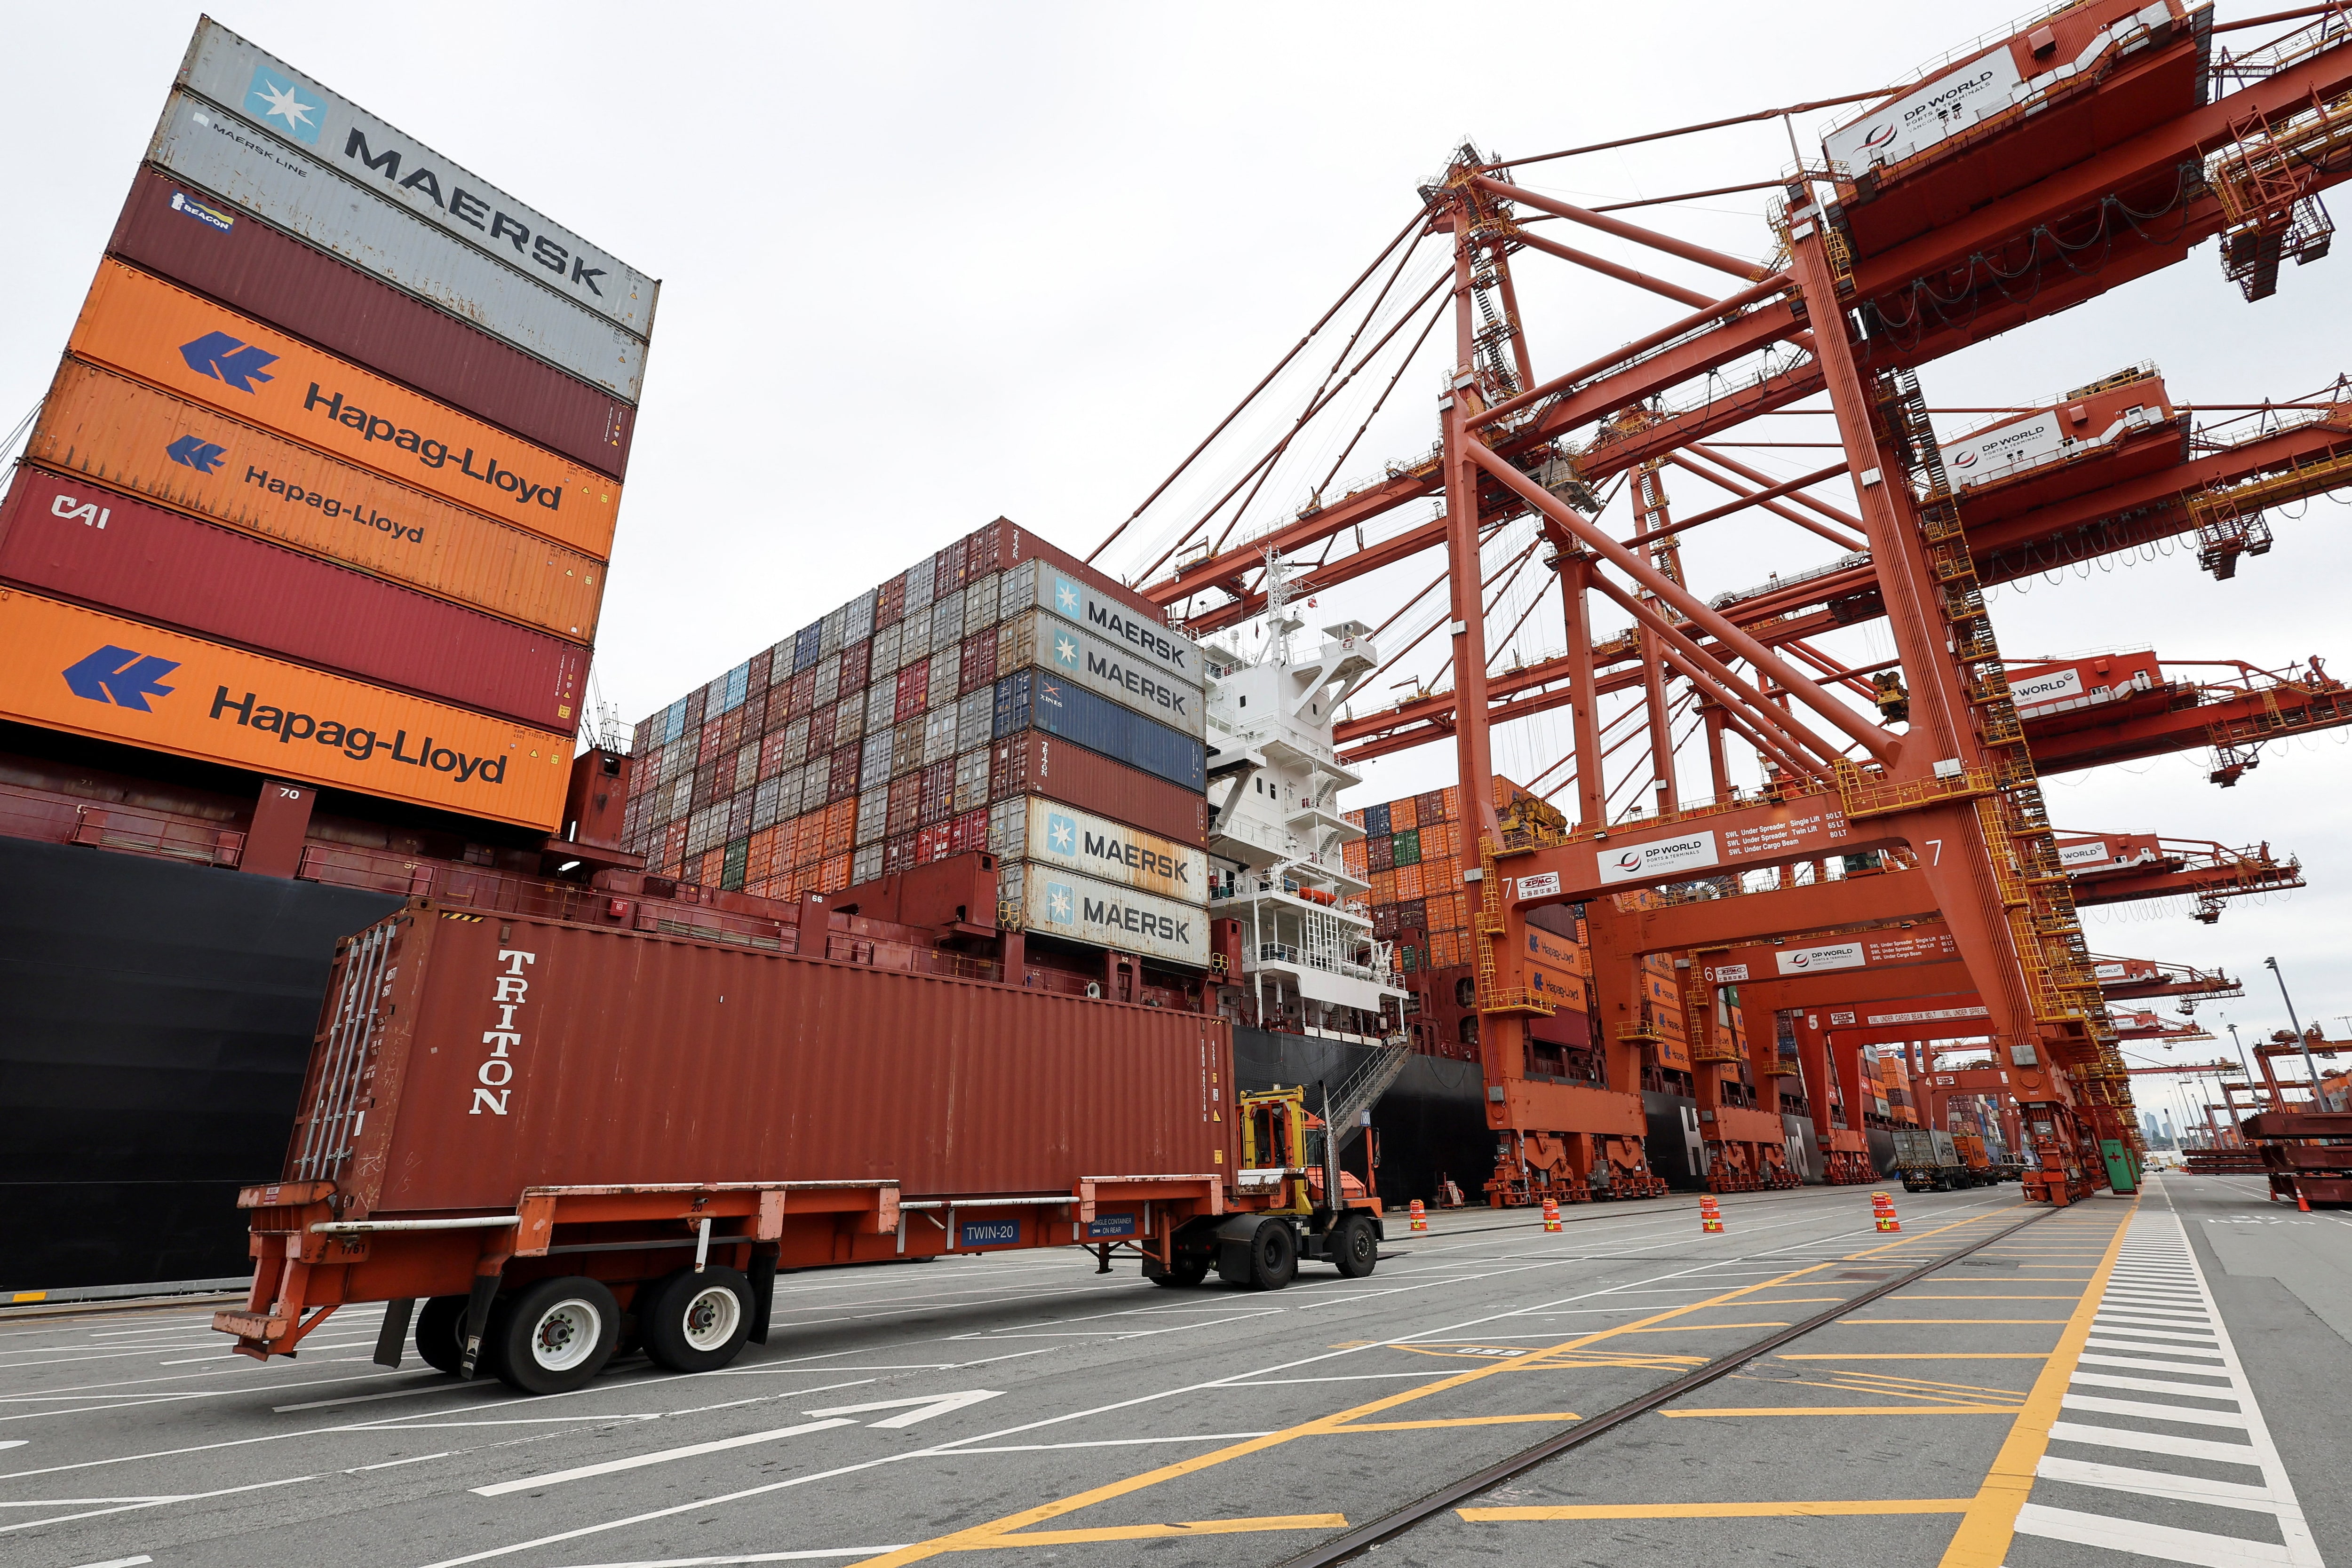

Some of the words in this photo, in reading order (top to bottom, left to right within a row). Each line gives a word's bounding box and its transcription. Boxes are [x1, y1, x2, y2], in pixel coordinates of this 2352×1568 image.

[1904, 105, 1926, 121] DP
[1928, 71, 1993, 107] WORLD
[1906, 114, 1931, 127] PORTS
[1942, 81, 1991, 110] TERMINALS
[213, 123, 273, 160] MAERSK
[276, 158, 308, 178] LINE
[184, 204, 229, 230] BEACON
[344, 127, 607, 298] MAERSK
[304, 381, 563, 511] Hapag-Lloyd
[1982, 442, 1997, 452] DP
[1999, 426, 2044, 445] WORLD
[1984, 448, 2003, 456] PORTS
[2010, 434, 2043, 448] TERMINALS
[51, 494, 111, 530] CAI
[245, 465, 425, 544] Hapag-Lloyd
[1089, 601, 1185, 669] MAERSK
[1088, 651, 1186, 716] MAERSK
[2018, 680, 2066, 696] WORLD
[1040, 694, 1063, 707] XINES
[209, 685, 508, 784] Hapag-Lloyd
[280, 787, 300, 800] 70
[1759, 823, 1786, 834] Spreader
[1790, 818, 1809, 827] Single
[1810, 815, 1820, 824] Lift
[1761, 832, 1788, 842] Spreader
[1792, 827, 1807, 836] Twin
[1808, 825, 1818, 833] Lift
[1085, 831, 1189, 883] MAERSK
[1646, 849, 1660, 857] DP
[1661, 841, 1701, 855] WORLD
[1670, 850, 1700, 859] TERMINALS
[1744, 845, 1762, 854] Under
[1763, 840, 1781, 850] Cargo
[1925, 839, 1942, 866] 7
[2064, 849, 2097, 859] WORLD
[1502, 877, 1512, 899] 7
[1525, 878, 1552, 887] ZPMC
[1084, 897, 1190, 944] MAERSK
[1823, 949, 1852, 957] WORLD
[1893, 939, 1912, 948] Spreader
[1704, 967, 1714, 982] 6
[1809, 1014, 1819, 1029] 5
[1969, 1006, 1988, 1015] SPREAD
[469, 949, 535, 1116] TRITON
[1925, 1077, 1932, 1087] 4
[967, 1226, 1013, 1240] TWIN-20
[341, 1243, 366, 1255] 1761
